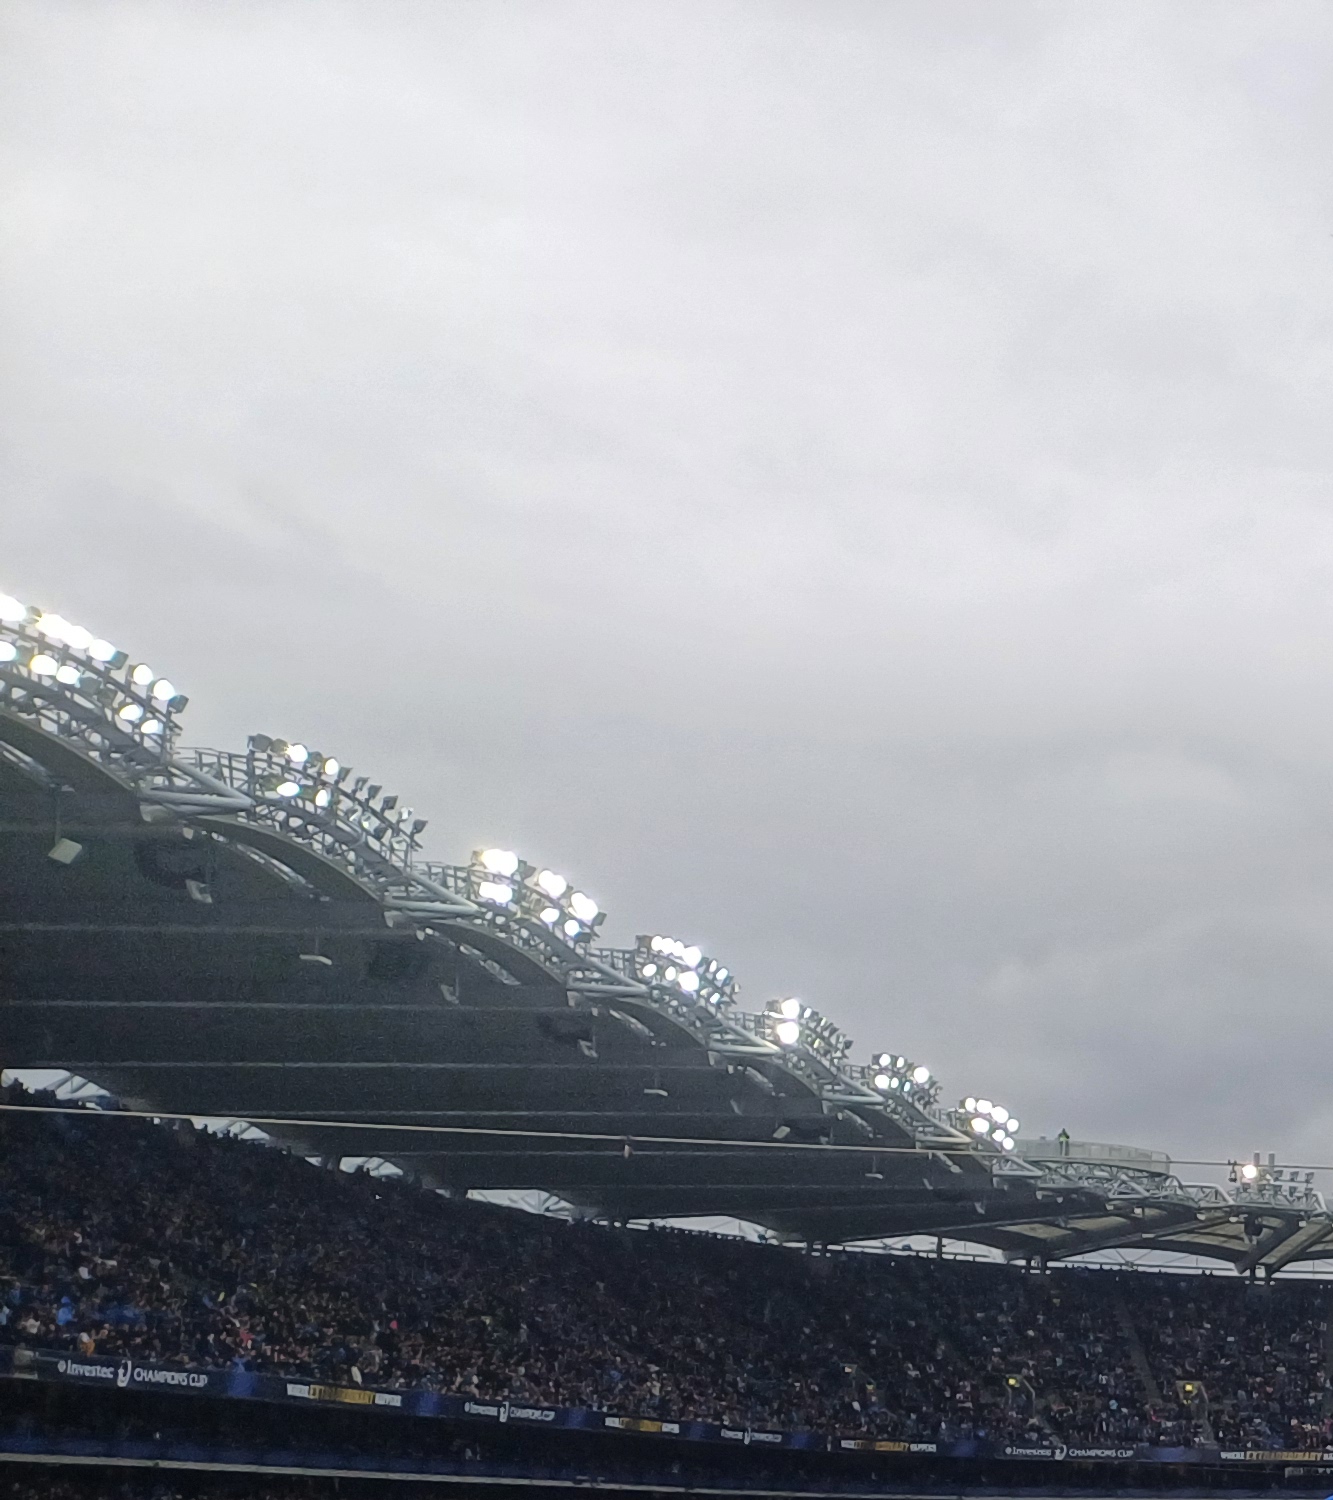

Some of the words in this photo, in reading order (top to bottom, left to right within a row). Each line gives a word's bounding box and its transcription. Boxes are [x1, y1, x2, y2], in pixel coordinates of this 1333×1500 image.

[67, 1360, 113, 1378] Investec
[134, 1368, 187, 1386] CHAMPIONS
[189, 1373, 208, 1387] CUP
